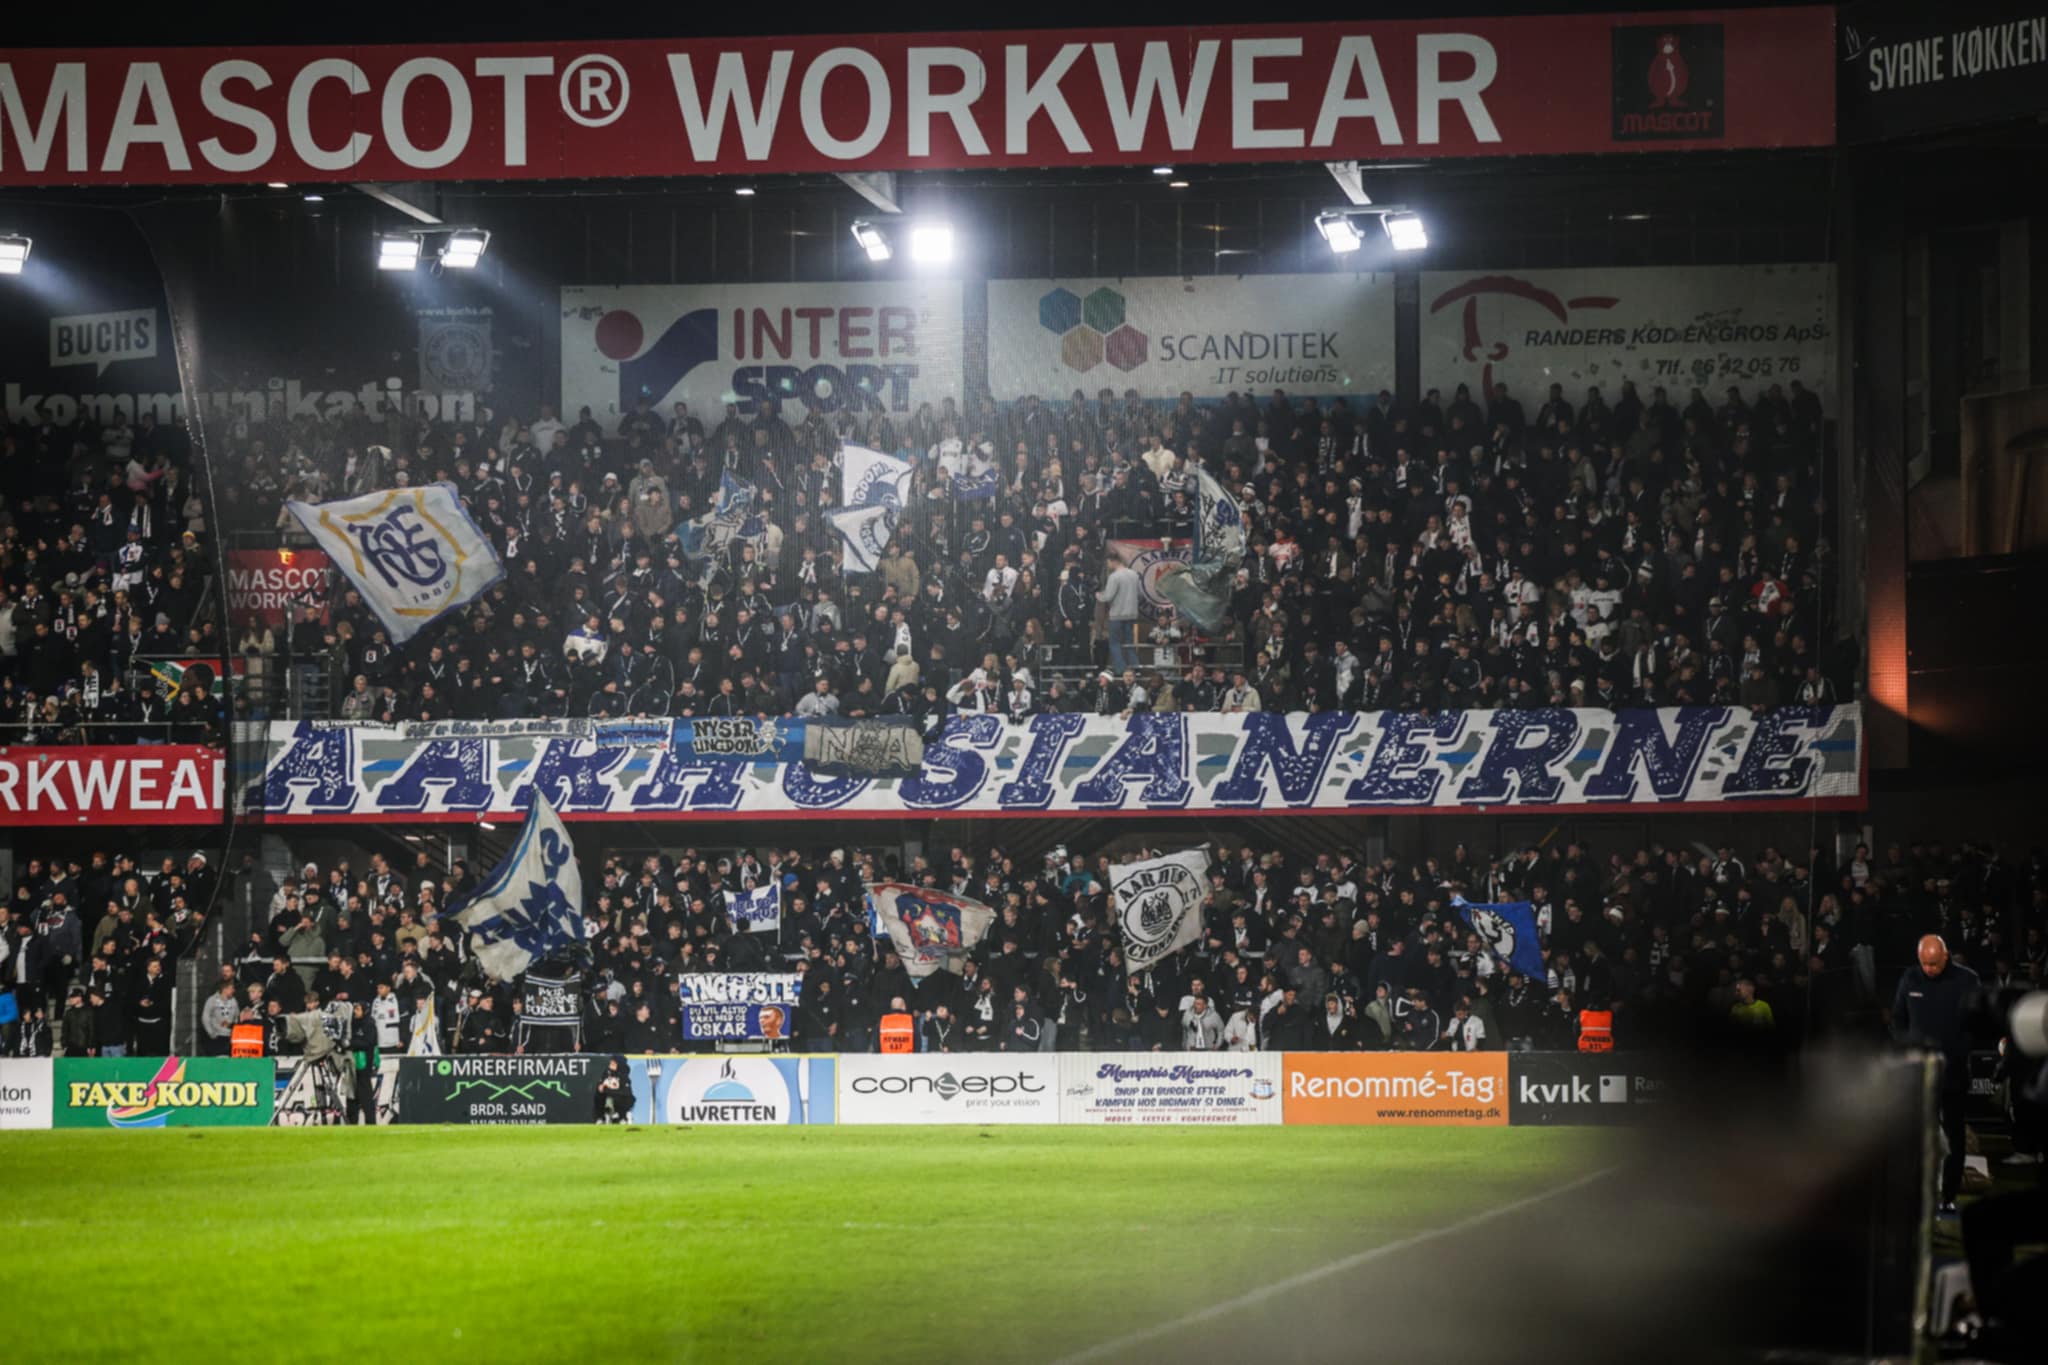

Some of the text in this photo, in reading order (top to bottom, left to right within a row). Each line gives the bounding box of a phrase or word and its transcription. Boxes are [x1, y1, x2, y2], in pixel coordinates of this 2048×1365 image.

[1869, 16, 2047, 92] SVANE KØKKEN
[667, 33, 1502, 163] WORKWEAR
[1622, 111, 1713, 134] MASCOT
[57, 317, 150, 357] BUCHS
[734, 306, 918, 360] INTER
[1524, 328, 1627, 347] RANDERS
[1717, 325, 1779, 343] GROS
[1160, 331, 1339, 362] SCANDITEK
[1215, 365, 1337, 385] IT solutions
[732, 363, 920, 415] SPORT
[228, 567, 333, 591] MASCOT
[691, 1022, 748, 1037] OSKAR
[1096, 1063, 1253, 1084] Memphis Mansion
[69, 1082, 258, 1107] FAXE KONDI
[852, 1071, 1046, 1101] consept
[1142, 1086, 1154, 1096] EN
[1157, 1086, 1195, 1096] BURGER
[1197, 1086, 1226, 1096] EFTER
[1291, 1070, 1495, 1103] Renommé-Tag
[1520, 1075, 1592, 1104] kvik
[470, 1103, 546, 1116] BRDR. SAND
[681, 1105, 776, 1122] LIVRETTEN
[966, 1098, 1040, 1108] print your vision
[1095, 1097, 1136, 1107] KAMPEN
[1137, 1097, 1157, 1107] HOS
[1159, 1097, 1203, 1107] HIGHWAY
[1216, 1097, 1246, 1107] DINER
[1376, 1107, 1501, 1119] www.renommetag.dk
